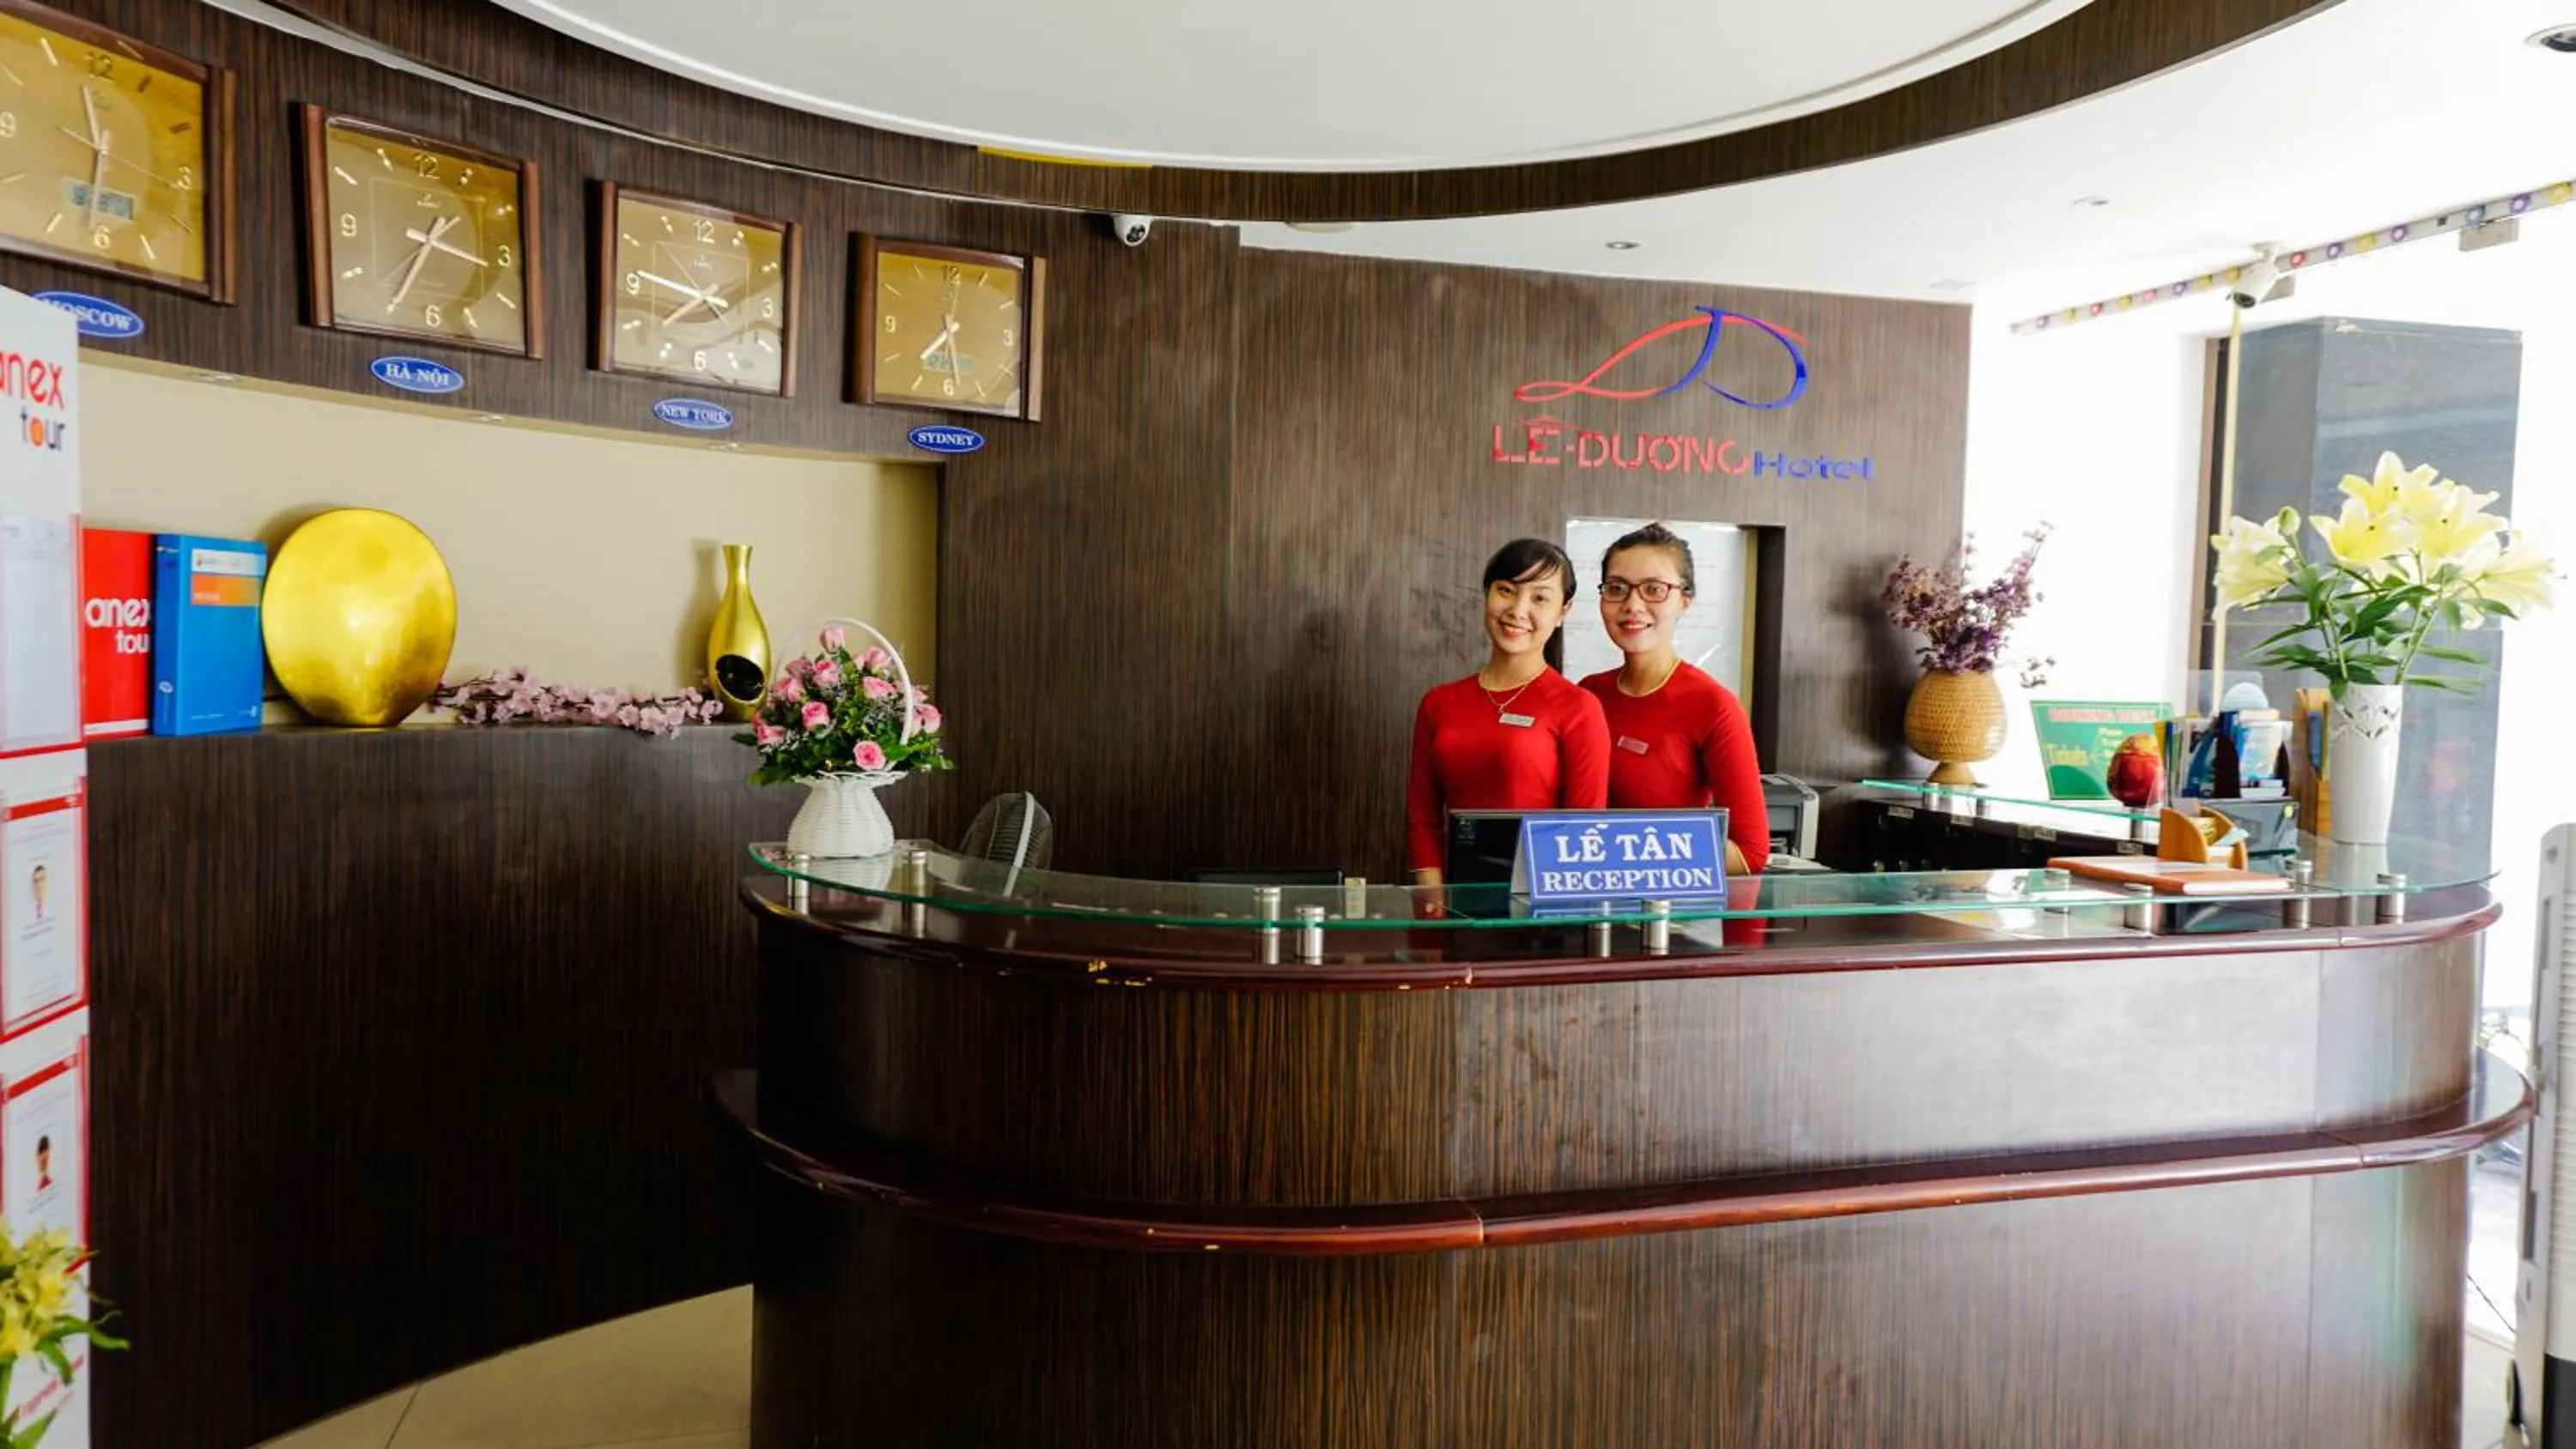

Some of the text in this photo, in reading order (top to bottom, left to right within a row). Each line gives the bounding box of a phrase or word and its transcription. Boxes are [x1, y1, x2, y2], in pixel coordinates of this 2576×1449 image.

[414, 154, 440, 179] 12
[94, 225, 110, 249] 6
[341, 213, 357, 237] 9
[693, 219, 715, 245] 12
[497, 245, 511, 267] 3
[626, 273, 641, 295] 9
[425, 305, 440, 327] 6
[762, 298, 774, 318] 3
[885, 315, 896, 333] 9
[1002, 329, 1013, 347] 3
[693, 350, 707, 371] 6
[0, 349, 65, 410] nex
[385, 361, 449, 387] HÀ NỘI
[944, 379, 955, 397] 6
[659, 403, 727, 424] NEW YORK
[20, 405, 65, 452] tour
[918, 432, 975, 446] SYDNEY
[1753, 451, 1874, 481] Hotel
[116, 629, 149, 654] tou
[1554, 823, 1693, 863] LỄ TÂN
[1541, 868, 1713, 892] RECEPTION
